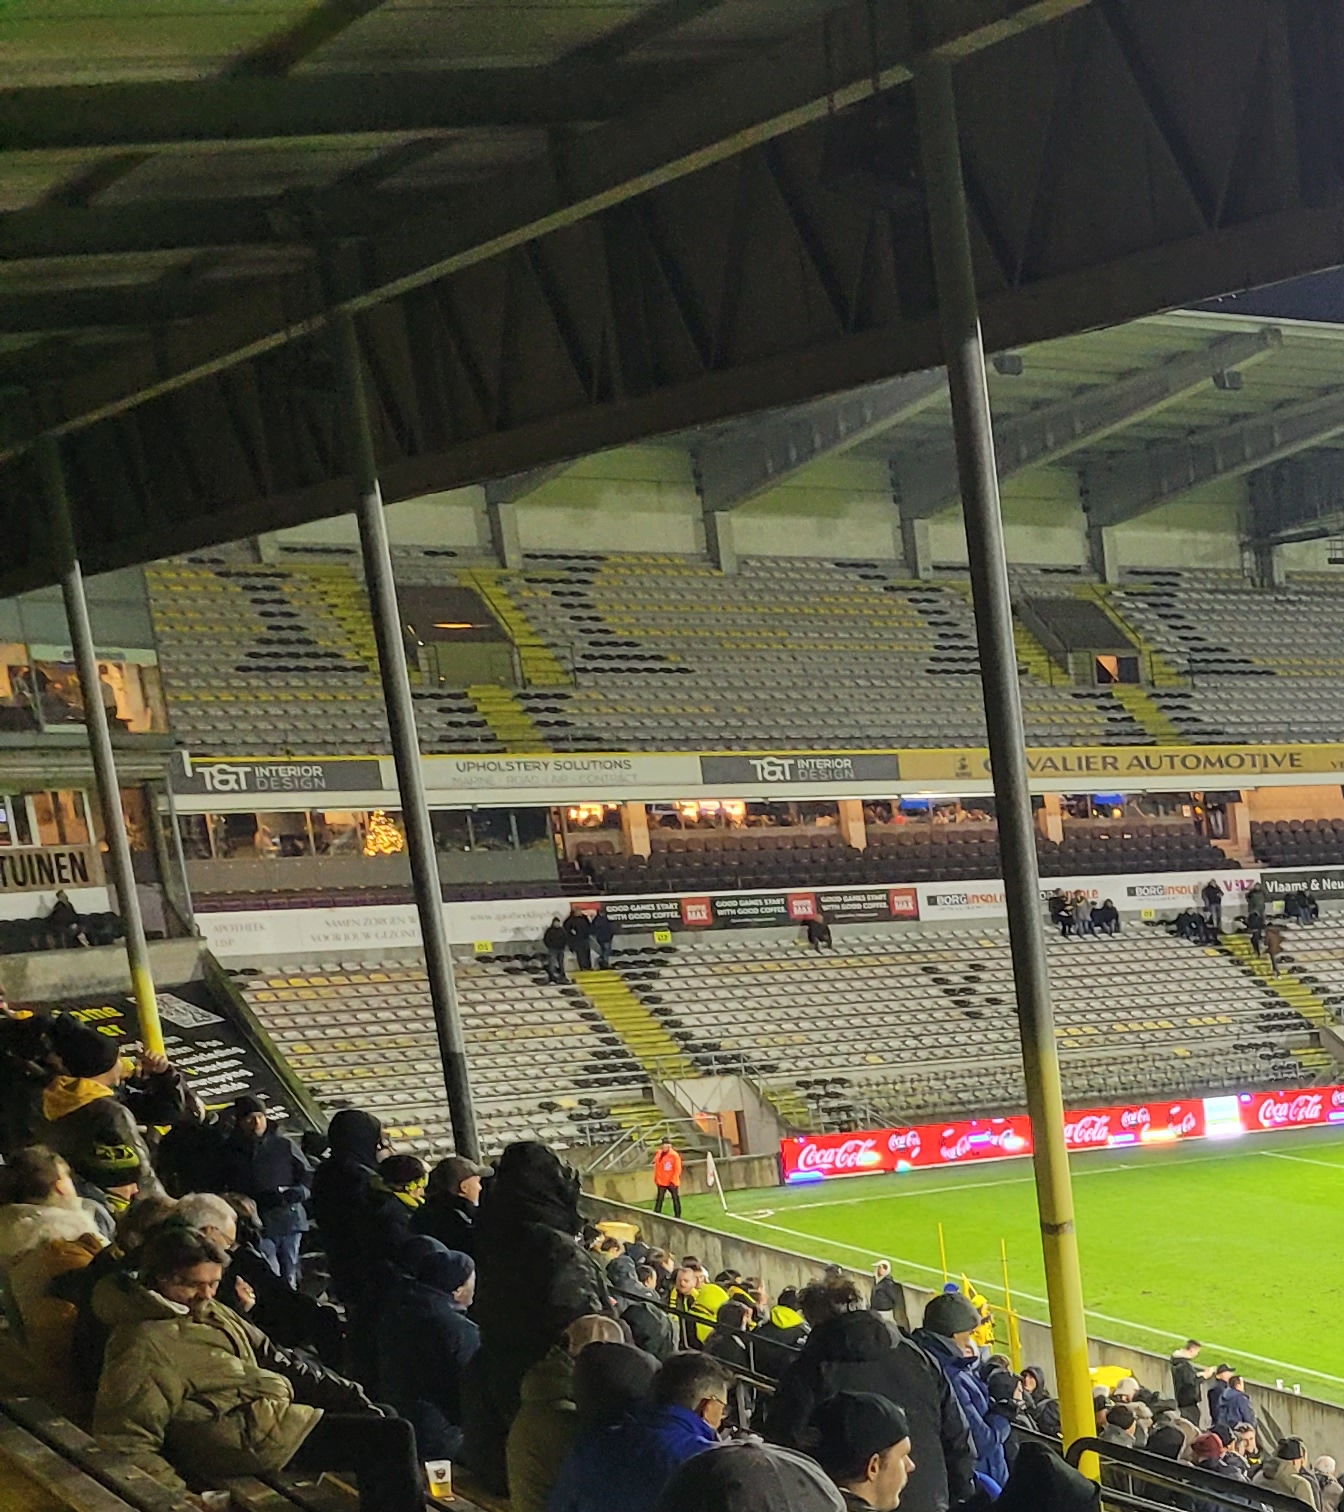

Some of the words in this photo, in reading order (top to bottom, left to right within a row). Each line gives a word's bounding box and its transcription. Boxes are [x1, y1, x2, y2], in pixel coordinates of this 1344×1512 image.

[456, 760, 549, 773] UPHOLSTERY
[554, 758, 632, 771] SOLUTIONS
[749, 757, 795, 782] T&T
[797, 758, 853, 770] INTERIOR
[983, 754, 1119, 773] CVALIER
[1126, 752, 1304, 771] AUTOMOTIVE
[196, 764, 251, 791] T&T
[255, 765, 323, 777] INTERIOR
[799, 769, 855, 781] DESIGN
[255, 777, 326, 790] DESIGN
[0, 851, 89, 888] TUINEN
[1265, 879, 1309, 893] Vlaams
[1310, 878, 1320, 890] &
